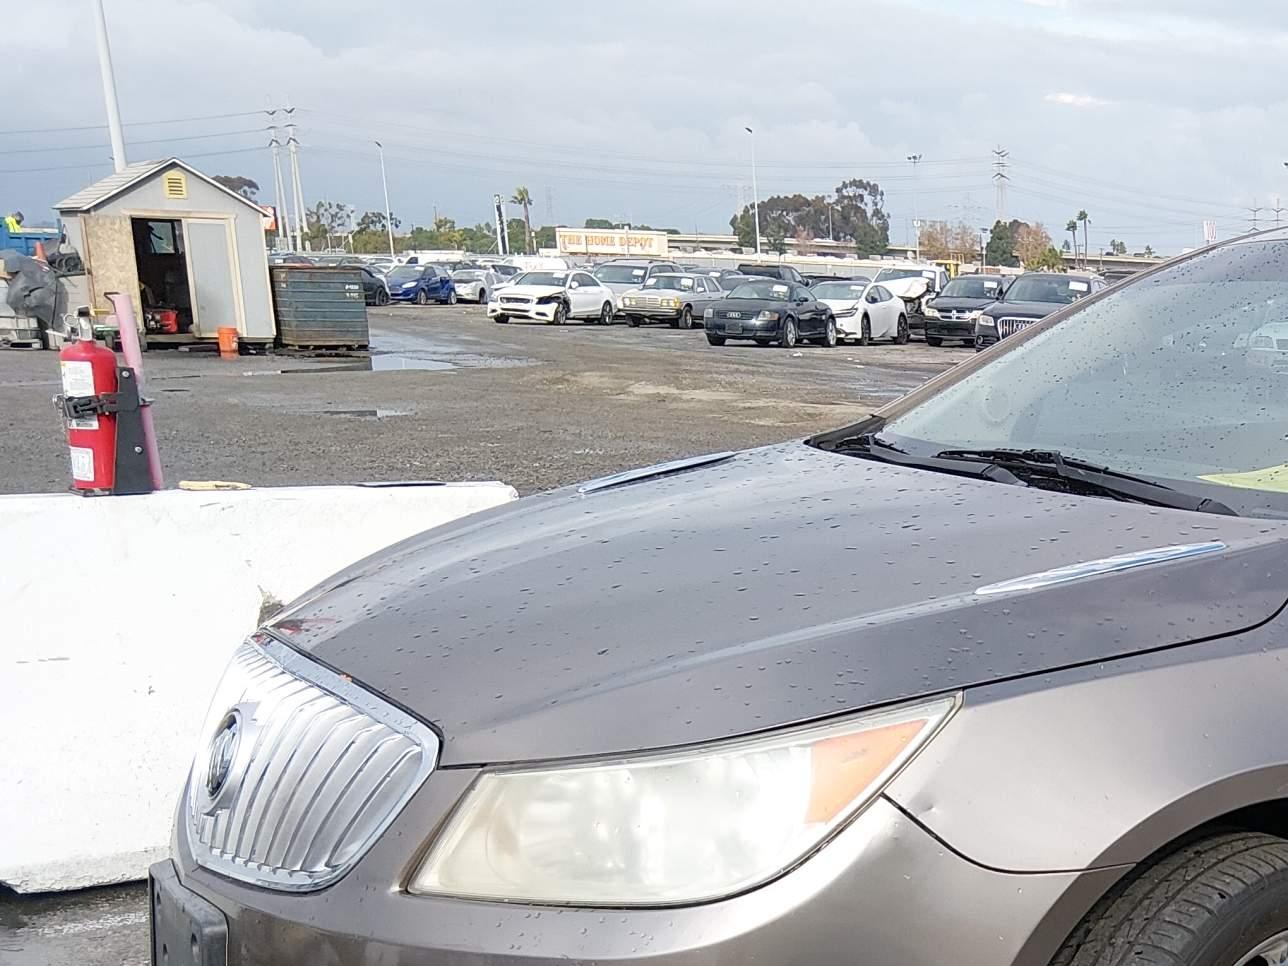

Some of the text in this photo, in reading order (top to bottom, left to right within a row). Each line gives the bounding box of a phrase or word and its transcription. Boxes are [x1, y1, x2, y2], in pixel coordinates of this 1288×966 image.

[560, 234, 654, 250] THE HOME DEPOT
